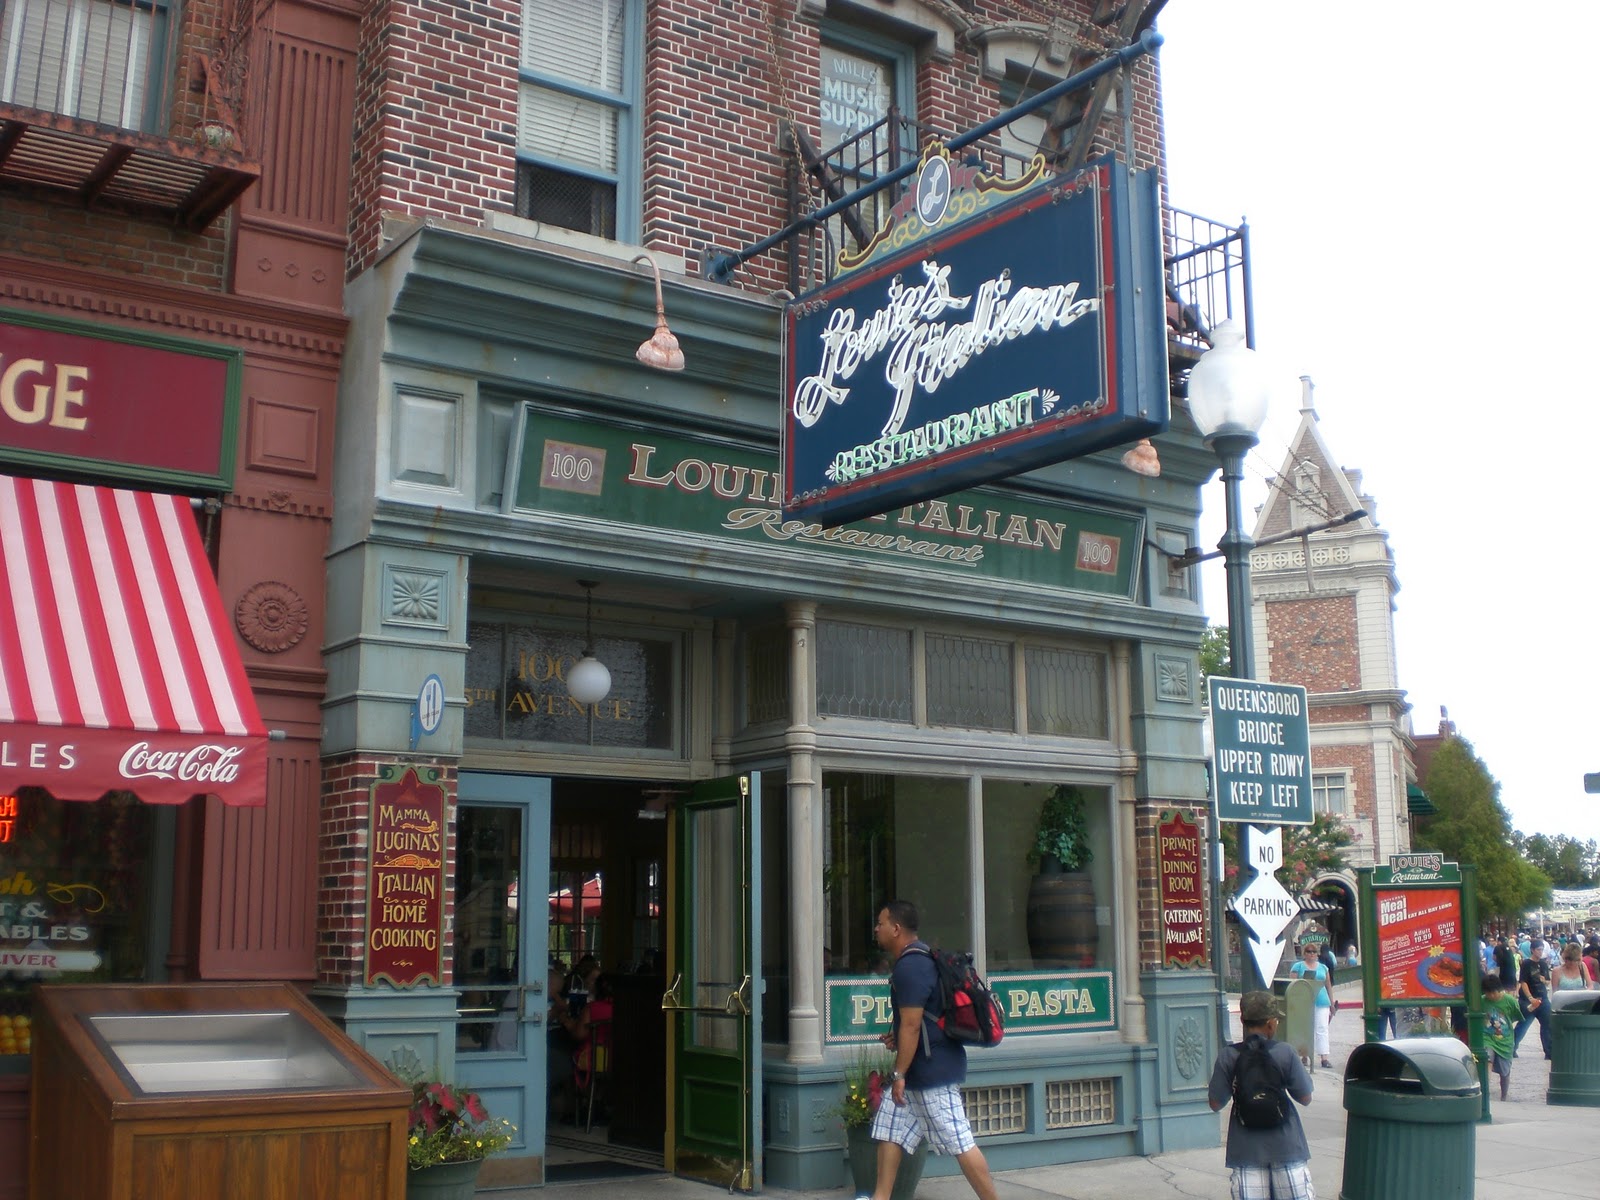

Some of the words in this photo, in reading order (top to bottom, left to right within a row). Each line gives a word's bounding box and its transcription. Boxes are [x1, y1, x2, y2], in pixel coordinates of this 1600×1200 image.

[833, 58, 878, 85] MILLS
[824, 76, 886, 113] MUSIC
[881, 272, 1102, 437] Italian
[0, 358, 88, 431] GE
[835, 388, 1039, 482] RESTAURANT
[551, 453, 593, 482] 100
[721, 508, 984, 563] Restaurant
[1083, 541, 1112, 566] 100
[506, 691, 635, 721] AVENUE
[1218, 686, 1300, 717] QUEENSBORO
[1238, 719, 1285, 746] BRIDGE
[1, 741, 77, 770] LES
[118, 741, 245, 783] Coca-Cola
[1219, 748, 1263, 775] UPPER
[1270, 753, 1305, 778] RDWY
[1230, 780, 1263, 806] KEEP
[1271, 783, 1299, 808] LEFT
[375, 830, 441, 854] LUGINA'S
[1162, 837, 1198, 856] PRIVATE
[1259, 845, 1275, 864] NO
[1391, 855, 1441, 874] LOUIE'S
[1163, 861, 1197, 874] DINING
[1390, 872, 1443, 883] Restaurant
[377, 872, 435, 900] ITALIAN
[1169, 877, 1195, 892] ROOM
[21, 901, 49, 919] &
[382, 904, 427, 923] HOME
[1164, 909, 1202, 925] CATERING
[1244, 897, 1292, 918] PARKING
[1381, 897, 1407, 914] Meal
[1381, 908, 1407, 926] Deal
[371, 927, 437, 951] COOKING
[1166, 927, 1203, 944] AVAILABLE
[1413, 928, 1431, 937] Adult
[1437, 921, 1455, 930] Child
[0, 953, 57, 969] IVER
[1008, 988, 1096, 1018] PASTA
